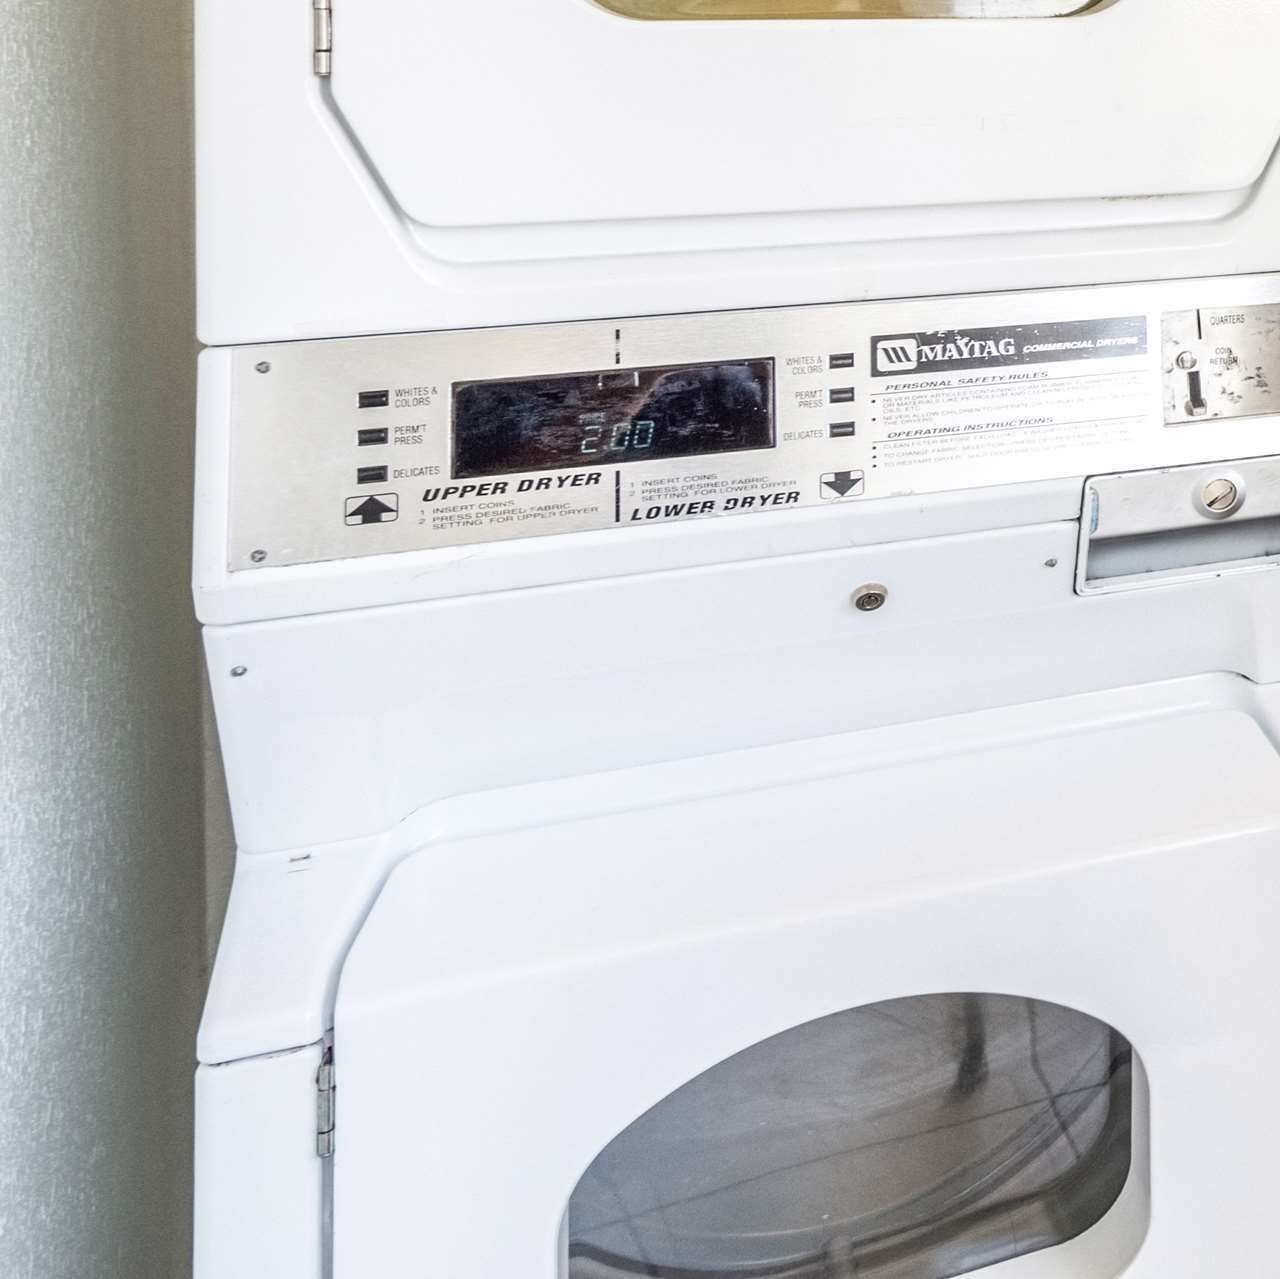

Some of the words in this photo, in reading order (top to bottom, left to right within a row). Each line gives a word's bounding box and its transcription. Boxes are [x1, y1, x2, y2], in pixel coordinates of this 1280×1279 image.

[1210, 314, 1245, 325] QUARTERS
[920, 336, 1015, 362] MAYTAG
[1022, 340, 1095, 354] COMMERCIAL
[1096, 336, 1138, 348] DRYERS
[785, 356, 815, 365] WHITES
[792, 365, 823, 375] COLORS
[884, 378, 953, 391] PERSONAL
[957, 375, 1006, 384] SAFETY
[1008, 371, 1048, 380] RULES
[395, 386, 429, 397] WHITES
[431, 386, 438, 395] &
[394, 397, 431, 408] COLORS
[798, 400, 823, 408] PRESS
[887, 426, 961, 439] OPERATING
[963, 416, 1054, 431] INSTRUCTIONS
[394, 434, 423, 445] PRESS
[783, 429, 824, 441] DELICATES
[393, 465, 440, 479] DELICATES
[422, 481, 508, 502] UPPER
[517, 472, 602, 493] DRYER
[641, 477, 680, 487] INSERT
[684, 473, 718, 482] COINS
[641, 486, 679, 496] PRESS
[681, 481, 729, 491] DESIRED
[731, 475, 769, 485] FABRIC
[642, 492, 689, 502] SETTING
[694, 488, 717, 497] FOR
[719, 484, 758, 494] LOWER
[761, 480, 797, 489] DRYER
[432, 503, 475, 514] INSERT
[478, 500, 515, 509] COINS
[432, 512, 473, 523] PRESS
[475, 508, 527, 519] DESIRED
[530, 502, 571, 512] FABRIC
[630, 500, 715, 521] LOWER
[723, 491, 800, 511] DRYER
[432, 519, 483, 530] SETTING
[489, 515, 514, 524] FOR
[517, 511, 557, 521] UPPER
[559, 506, 600, 517] DRYER
